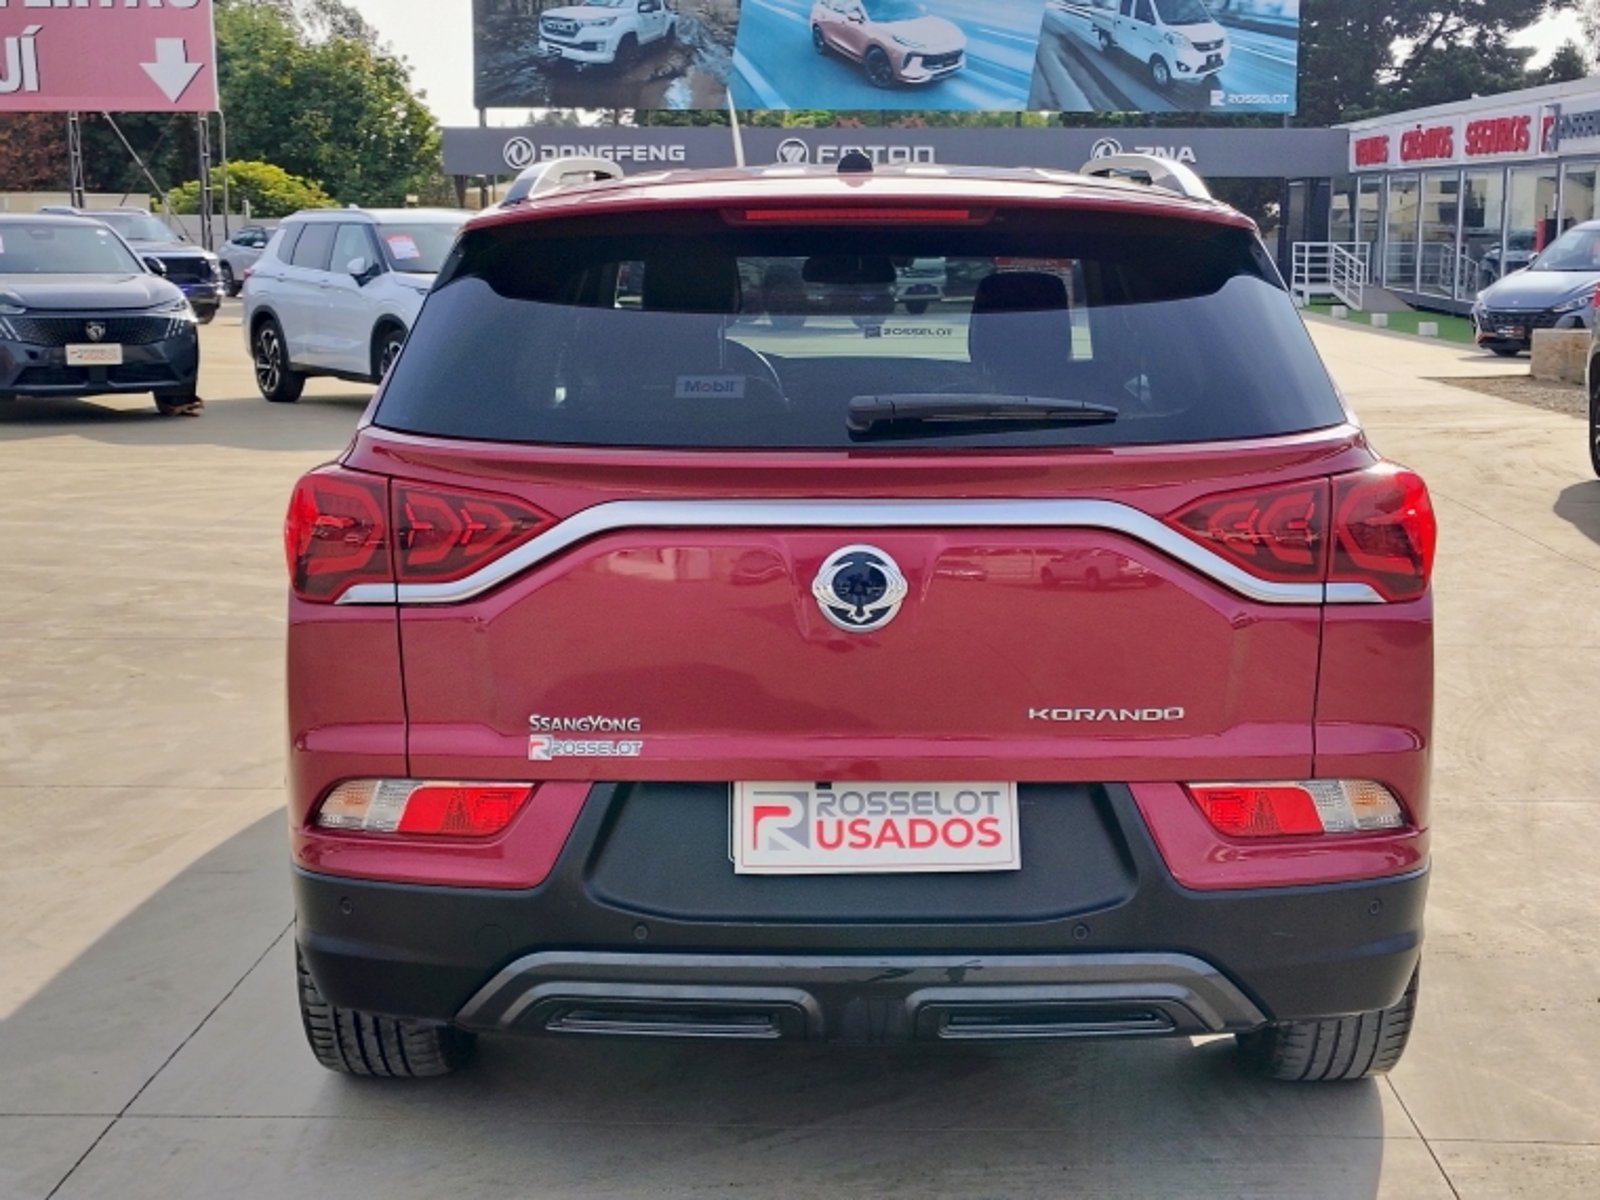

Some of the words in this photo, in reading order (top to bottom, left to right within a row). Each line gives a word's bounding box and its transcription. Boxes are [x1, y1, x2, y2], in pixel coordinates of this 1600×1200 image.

[540, 144, 686, 162] DONGFENG
[684, 380, 735, 393] Mobil
[1028, 706, 1185, 721] KORANDO
[816, 790, 1001, 817] ROSSELOT
[816, 816, 1003, 851] USADOS
